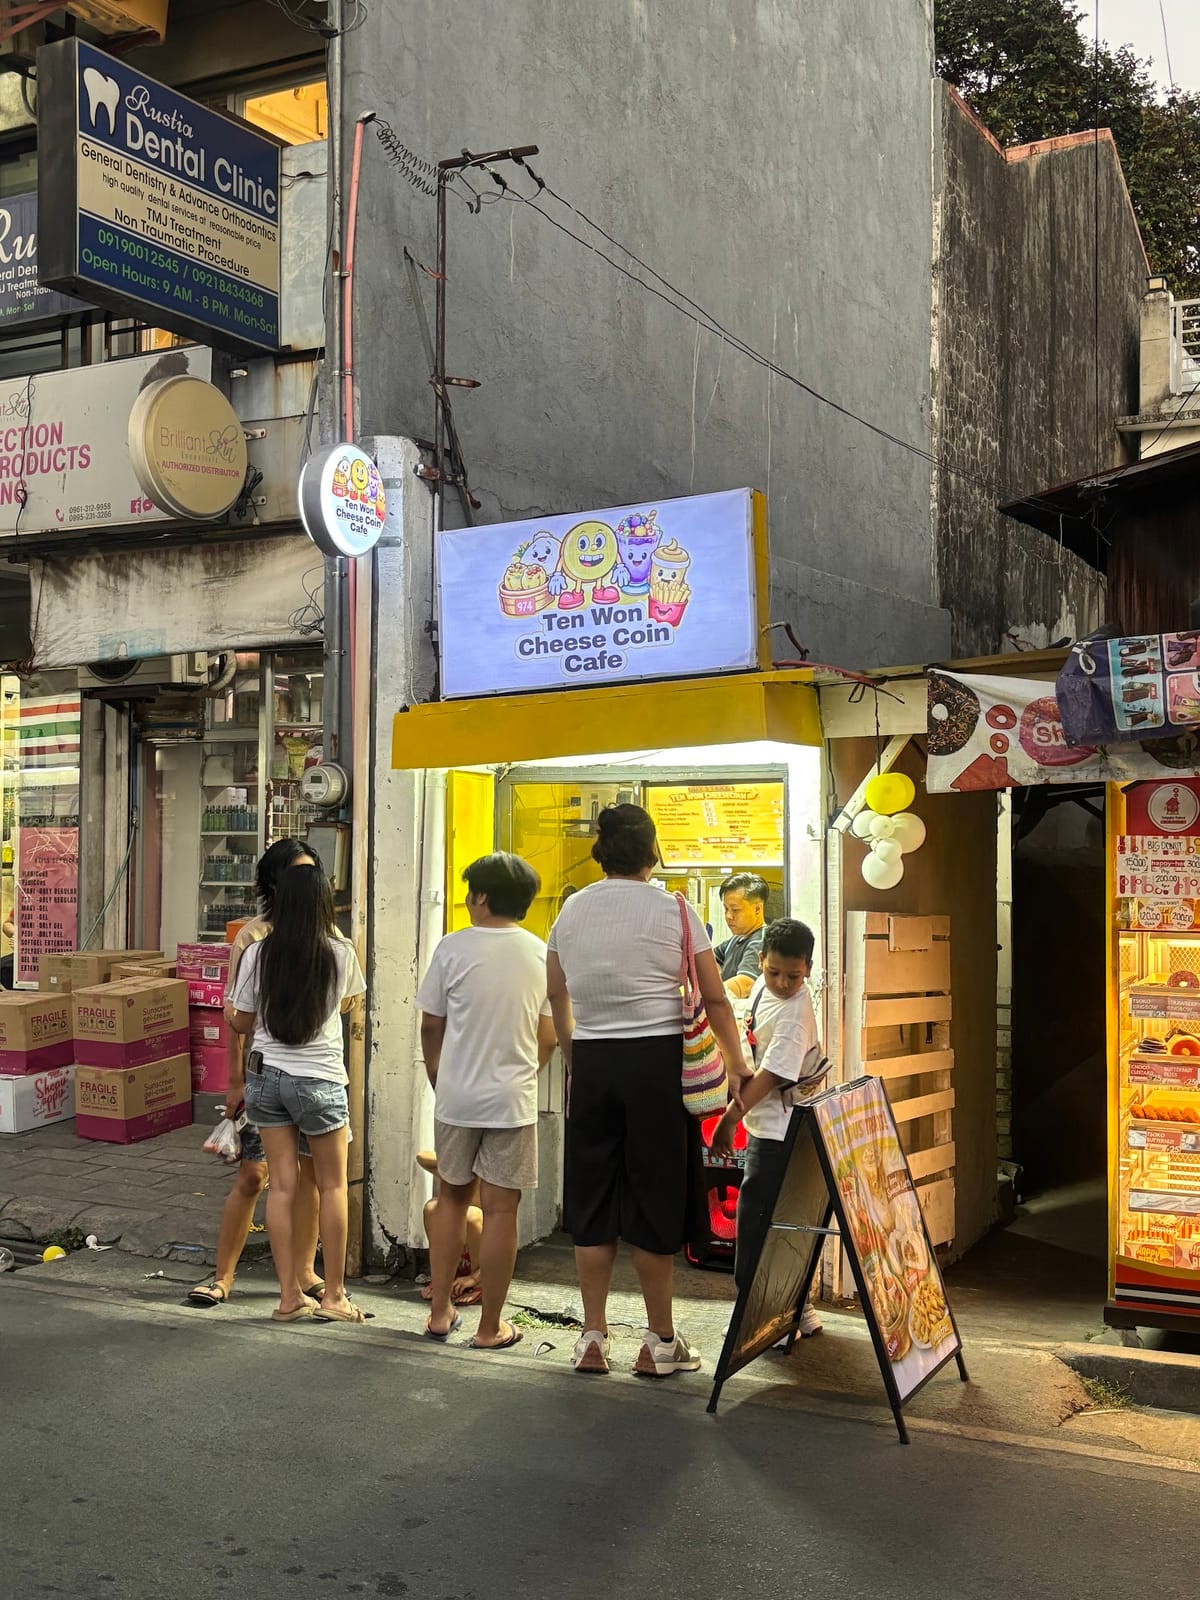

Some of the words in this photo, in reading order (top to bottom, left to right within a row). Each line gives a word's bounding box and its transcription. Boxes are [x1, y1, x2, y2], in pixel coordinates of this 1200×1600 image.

[125, 85, 193, 138] Rustia
[127, 112, 205, 181] Dental
[214, 158, 276, 214] Clinic
[81, 143, 122, 172] General
[126, 162, 167, 196] Dentistry
[170, 184, 176, 197] &
[179, 188, 219, 216] Advance
[222, 208, 276, 242] Orthodontics
[102, 172, 119, 188] high
[120, 180, 144, 200] quality
[147, 193, 169, 208] dental
[171, 203, 198, 222] services
[200, 214, 206, 224] at
[209, 220, 244, 240] reasonable
[246, 235, 261, 250] price
[146, 208, 168, 227] TMJ
[170, 217, 221, 250] Treatment
[115, 208, 138, 229] Non
[141, 220, 195, 254] Traumatic
[198, 244, 250, 276] Procedure
[0, 267, 15, 281] ral
[82, 249, 118, 273] Open
[122, 263, 160, 290] Hours:
[163, 280, 170, 293] 9
[173, 285, 193, 303] AM
[202, 296, 209, 309] 8
[234, 307, 276, 335] Mon-Sat
[0, 421, 63, 453] CTION
[160, 427, 206, 451] Brilliant
[162, 460, 200, 473] AUTHORIZED
[201, 465, 241, 478] DISTRIBUTOR
[336, 508, 363, 522] Cheese
[365, 516, 381, 528] Coin
[345, 499, 358, 511] Ten
[360, 503, 374, 515] Won
[350, 522, 368, 535] Cafe
[543, 613, 584, 631] Ten
[591, 607, 642, 626] Won
[519, 633, 607, 655] Cheese
[613, 624, 670, 645] Coin
[565, 650, 622, 672] Cafe
[31, 1009, 68, 1026] FRAGILE
[78, 1006, 116, 1019] FRAGILE
[143, 1003, 174, 1016] Sunscreen
[80, 1081, 117, 1095] FRAGILE
[143, 1076, 176, 1090] Sunscreen
